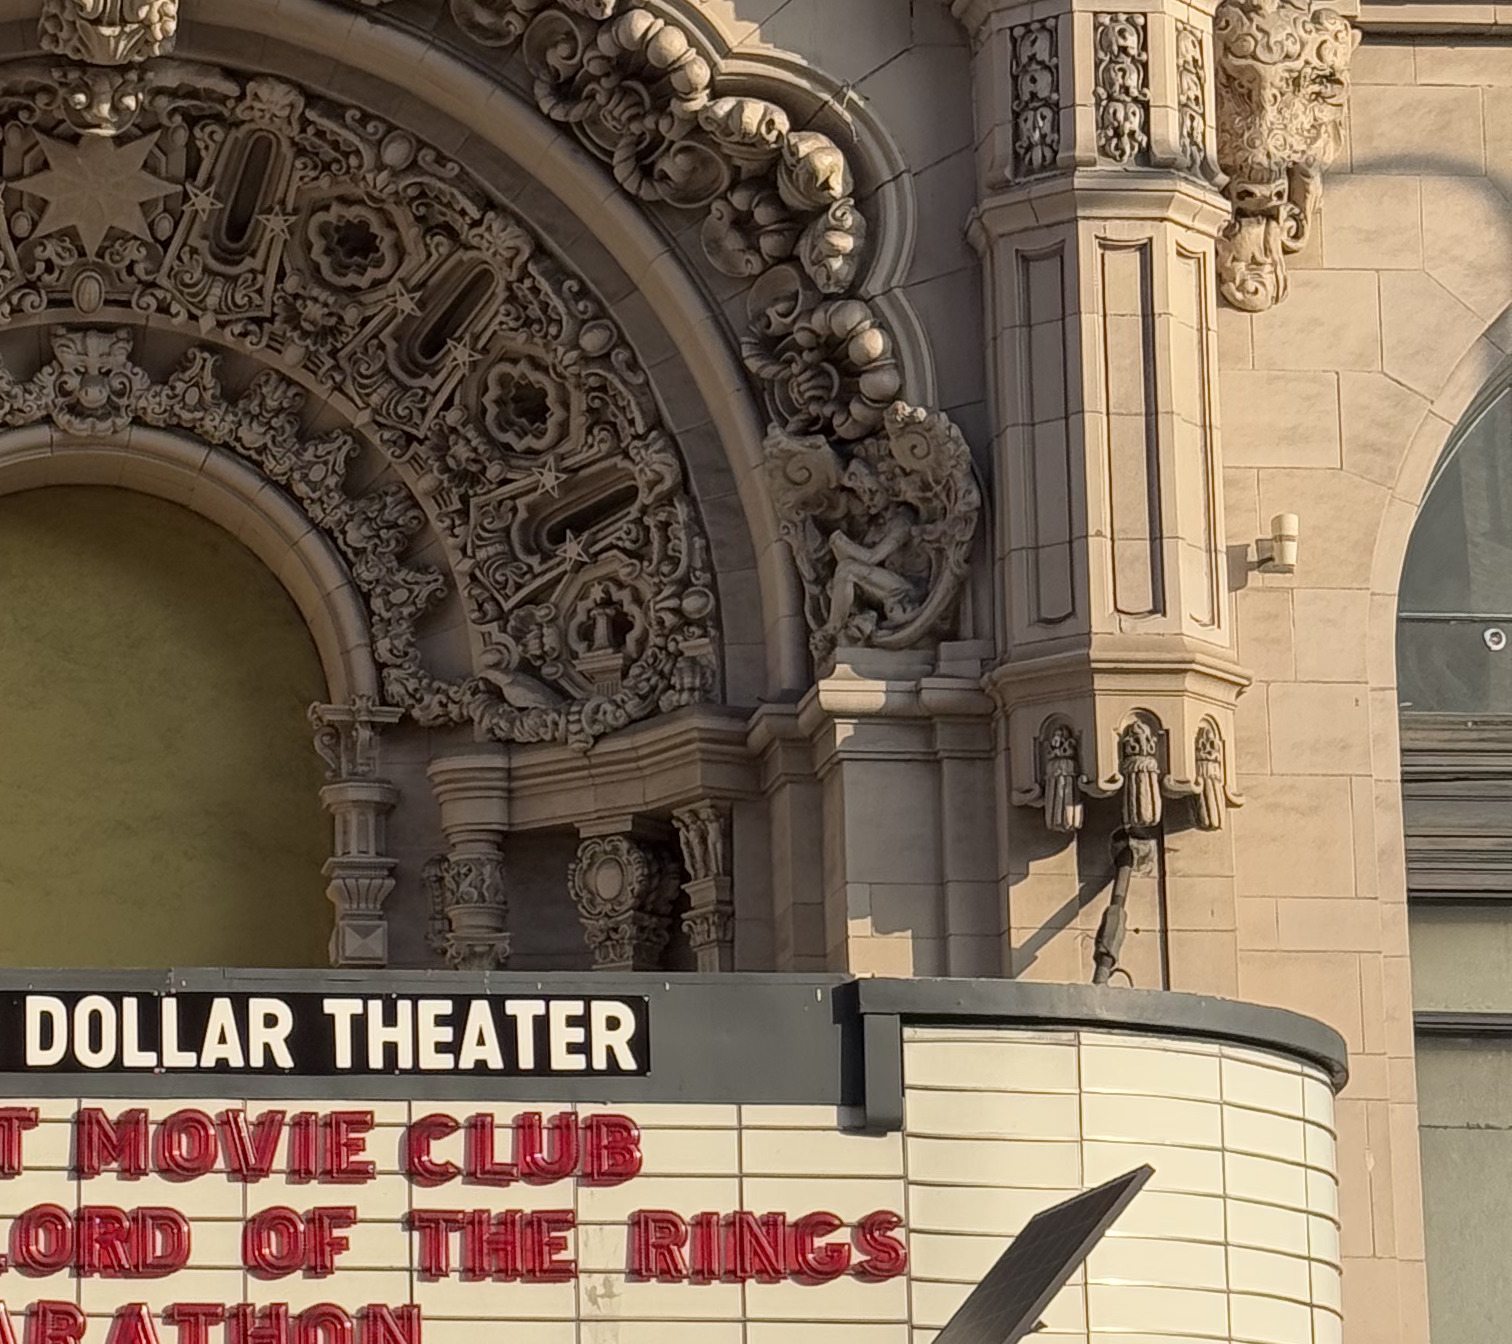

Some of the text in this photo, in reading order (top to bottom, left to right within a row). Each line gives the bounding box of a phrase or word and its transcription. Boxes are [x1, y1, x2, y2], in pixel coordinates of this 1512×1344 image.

[25, 995, 294, 1070] DOLLAR
[323, 997, 638, 1072] THEATER
[76, 1106, 375, 1181] MOVIE
[406, 1111, 643, 1187] CLUB
[245, 1205, 357, 1279] OF
[406, 1208, 579, 1282] THE
[628, 1209, 909, 1285] RINGS
